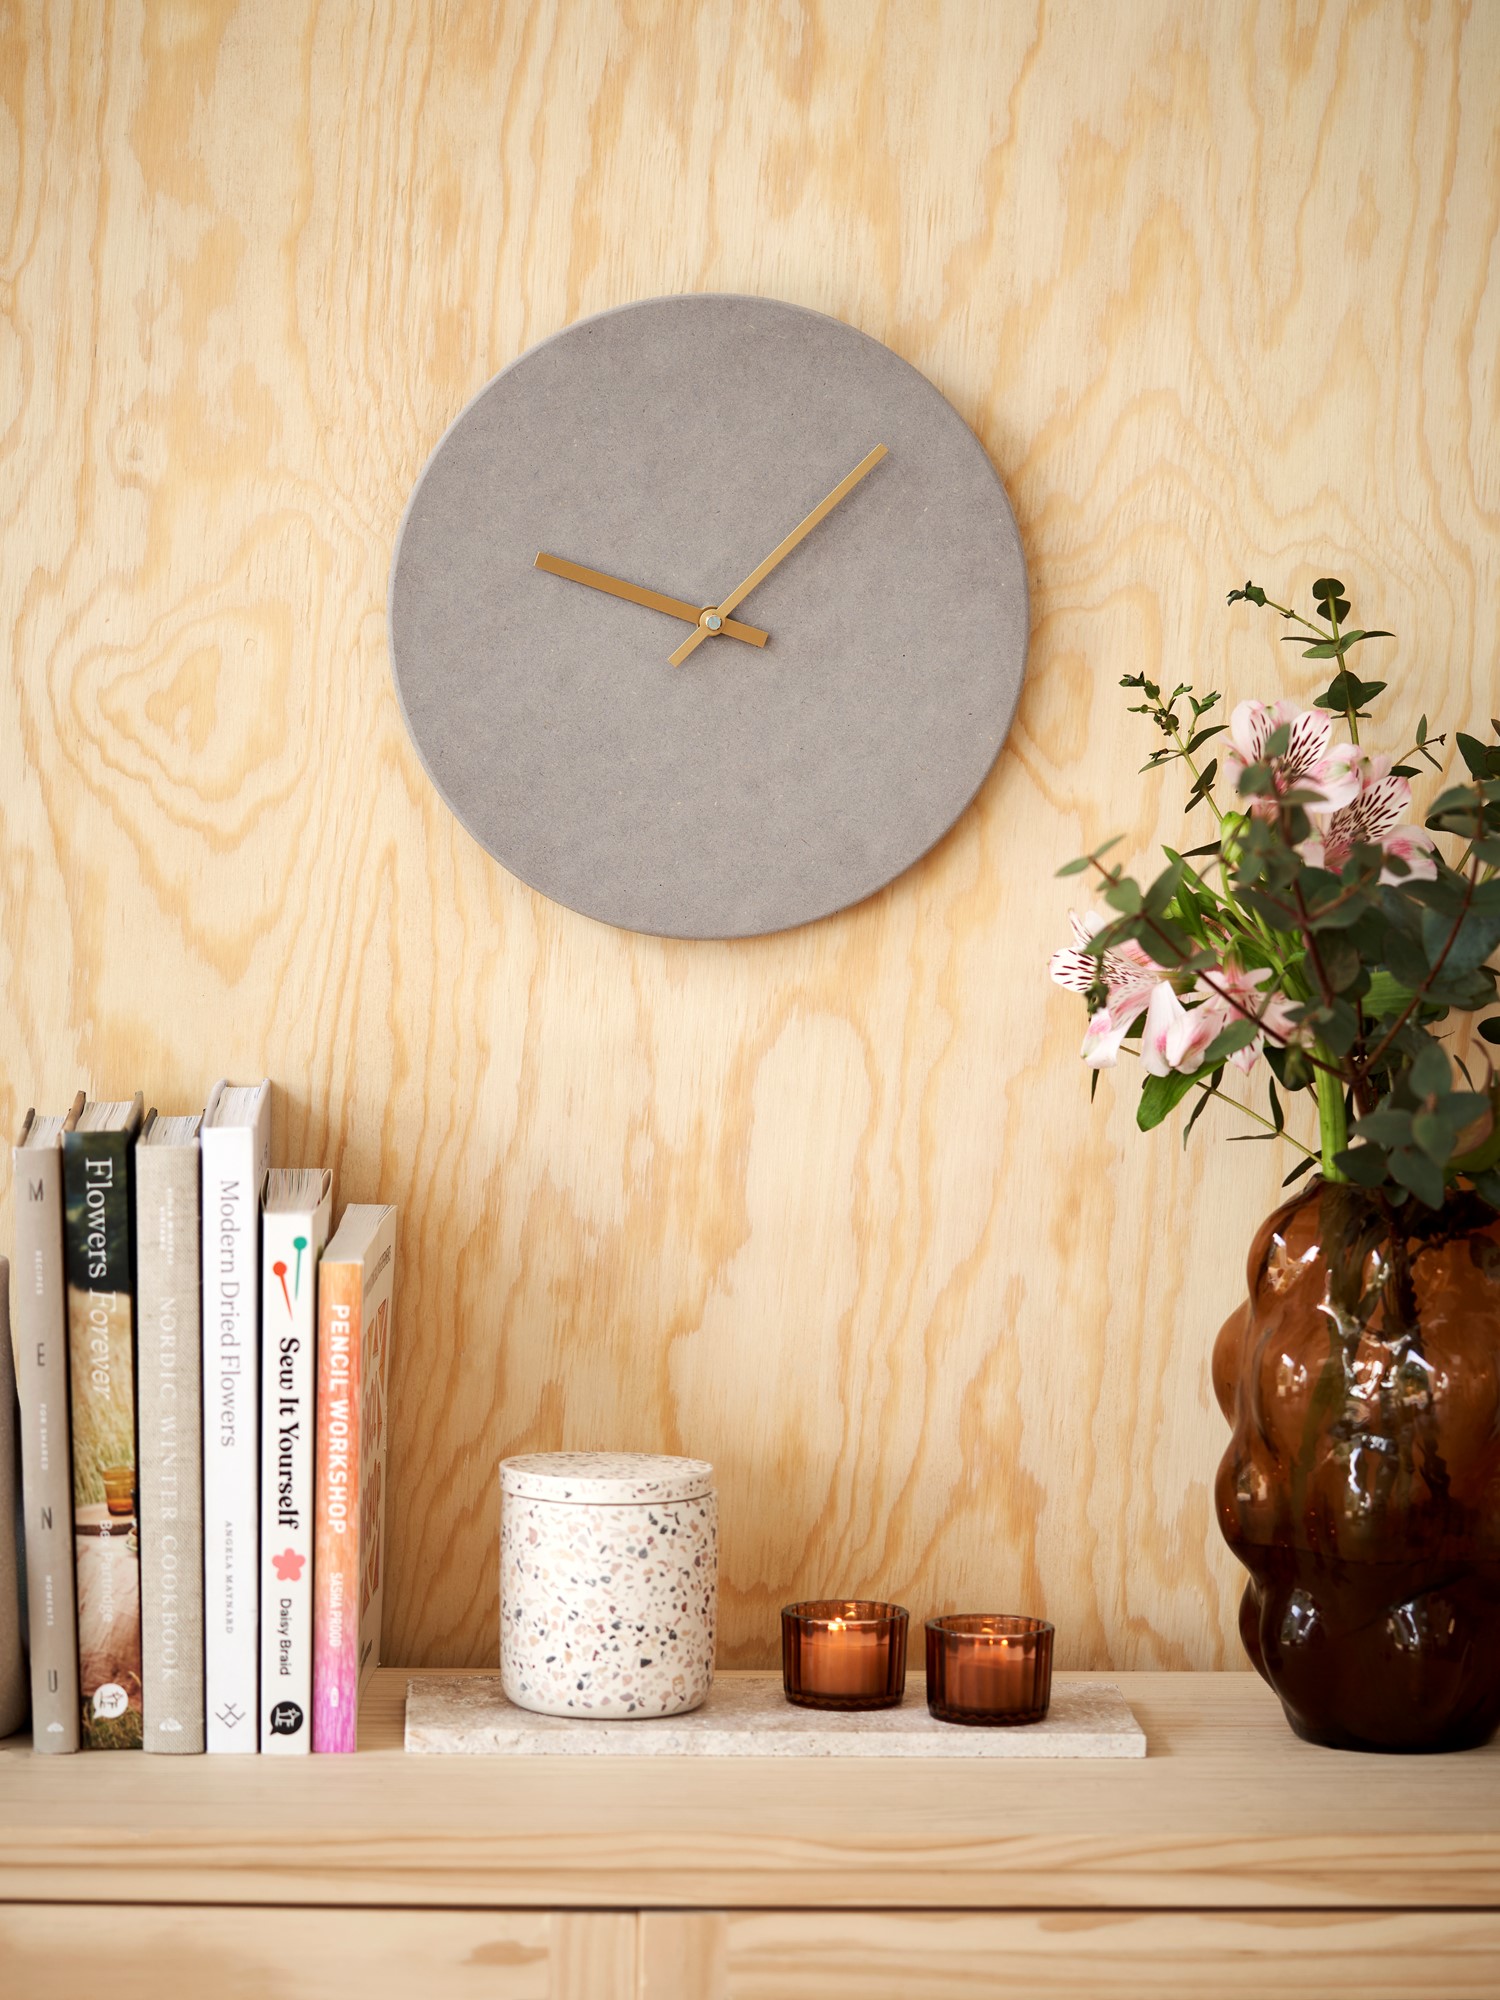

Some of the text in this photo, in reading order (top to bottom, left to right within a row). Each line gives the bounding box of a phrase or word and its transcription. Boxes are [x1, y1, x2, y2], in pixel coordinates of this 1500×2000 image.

[86, 1157, 117, 1400] Flowers Forever
[220, 1180, 241, 1447] Modern Dried Flowers
[35, 1250, 53, 1626] RECIPES FOR SHARED MOMENTS
[159, 1297, 178, 1681] NORDIC WINTER COOKBOOK
[278, 1337, 300, 1530] Sew It Yourself
[328, 1304, 351, 1534] PENCIL WORKSHOP
[99, 1520, 112, 1622] Bex Partridge
[225, 1520, 234, 1634] ANGELA MAYNARD
[278, 1598, 292, 1675] Daisy Braid
[329, 1572, 343, 1648] SASHA PROOD
